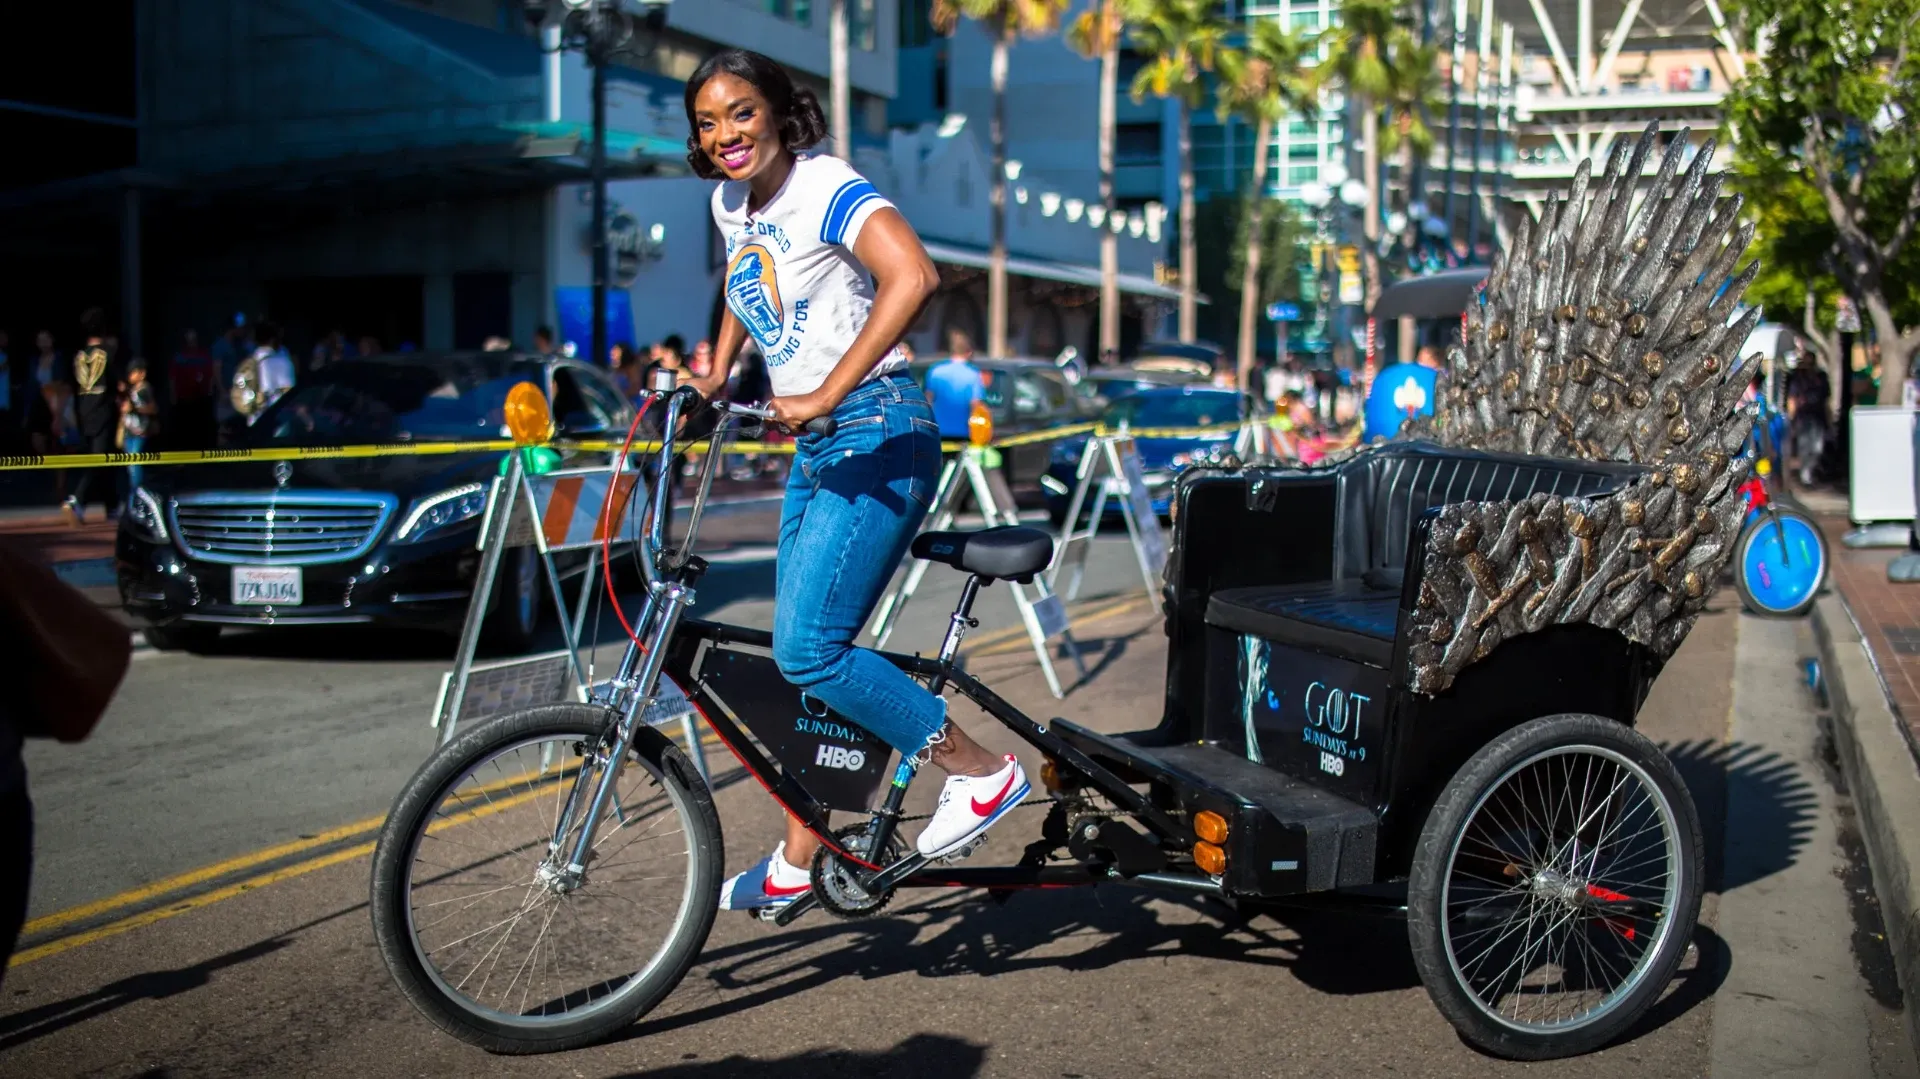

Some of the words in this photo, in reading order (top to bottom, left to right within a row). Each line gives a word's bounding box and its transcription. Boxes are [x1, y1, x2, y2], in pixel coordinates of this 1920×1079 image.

[766, 335, 801, 367] OOKING
[792, 298, 809, 334] FOR
[1305, 681, 1371, 740] GOT
[795, 718, 864, 742] SUNDAYS
[1302, 727, 1348, 756] SUNDAYS
[1358, 746, 1366, 762] 9
[815, 743, 866, 772] HBO
[1320, 751, 1344, 777] HBO
